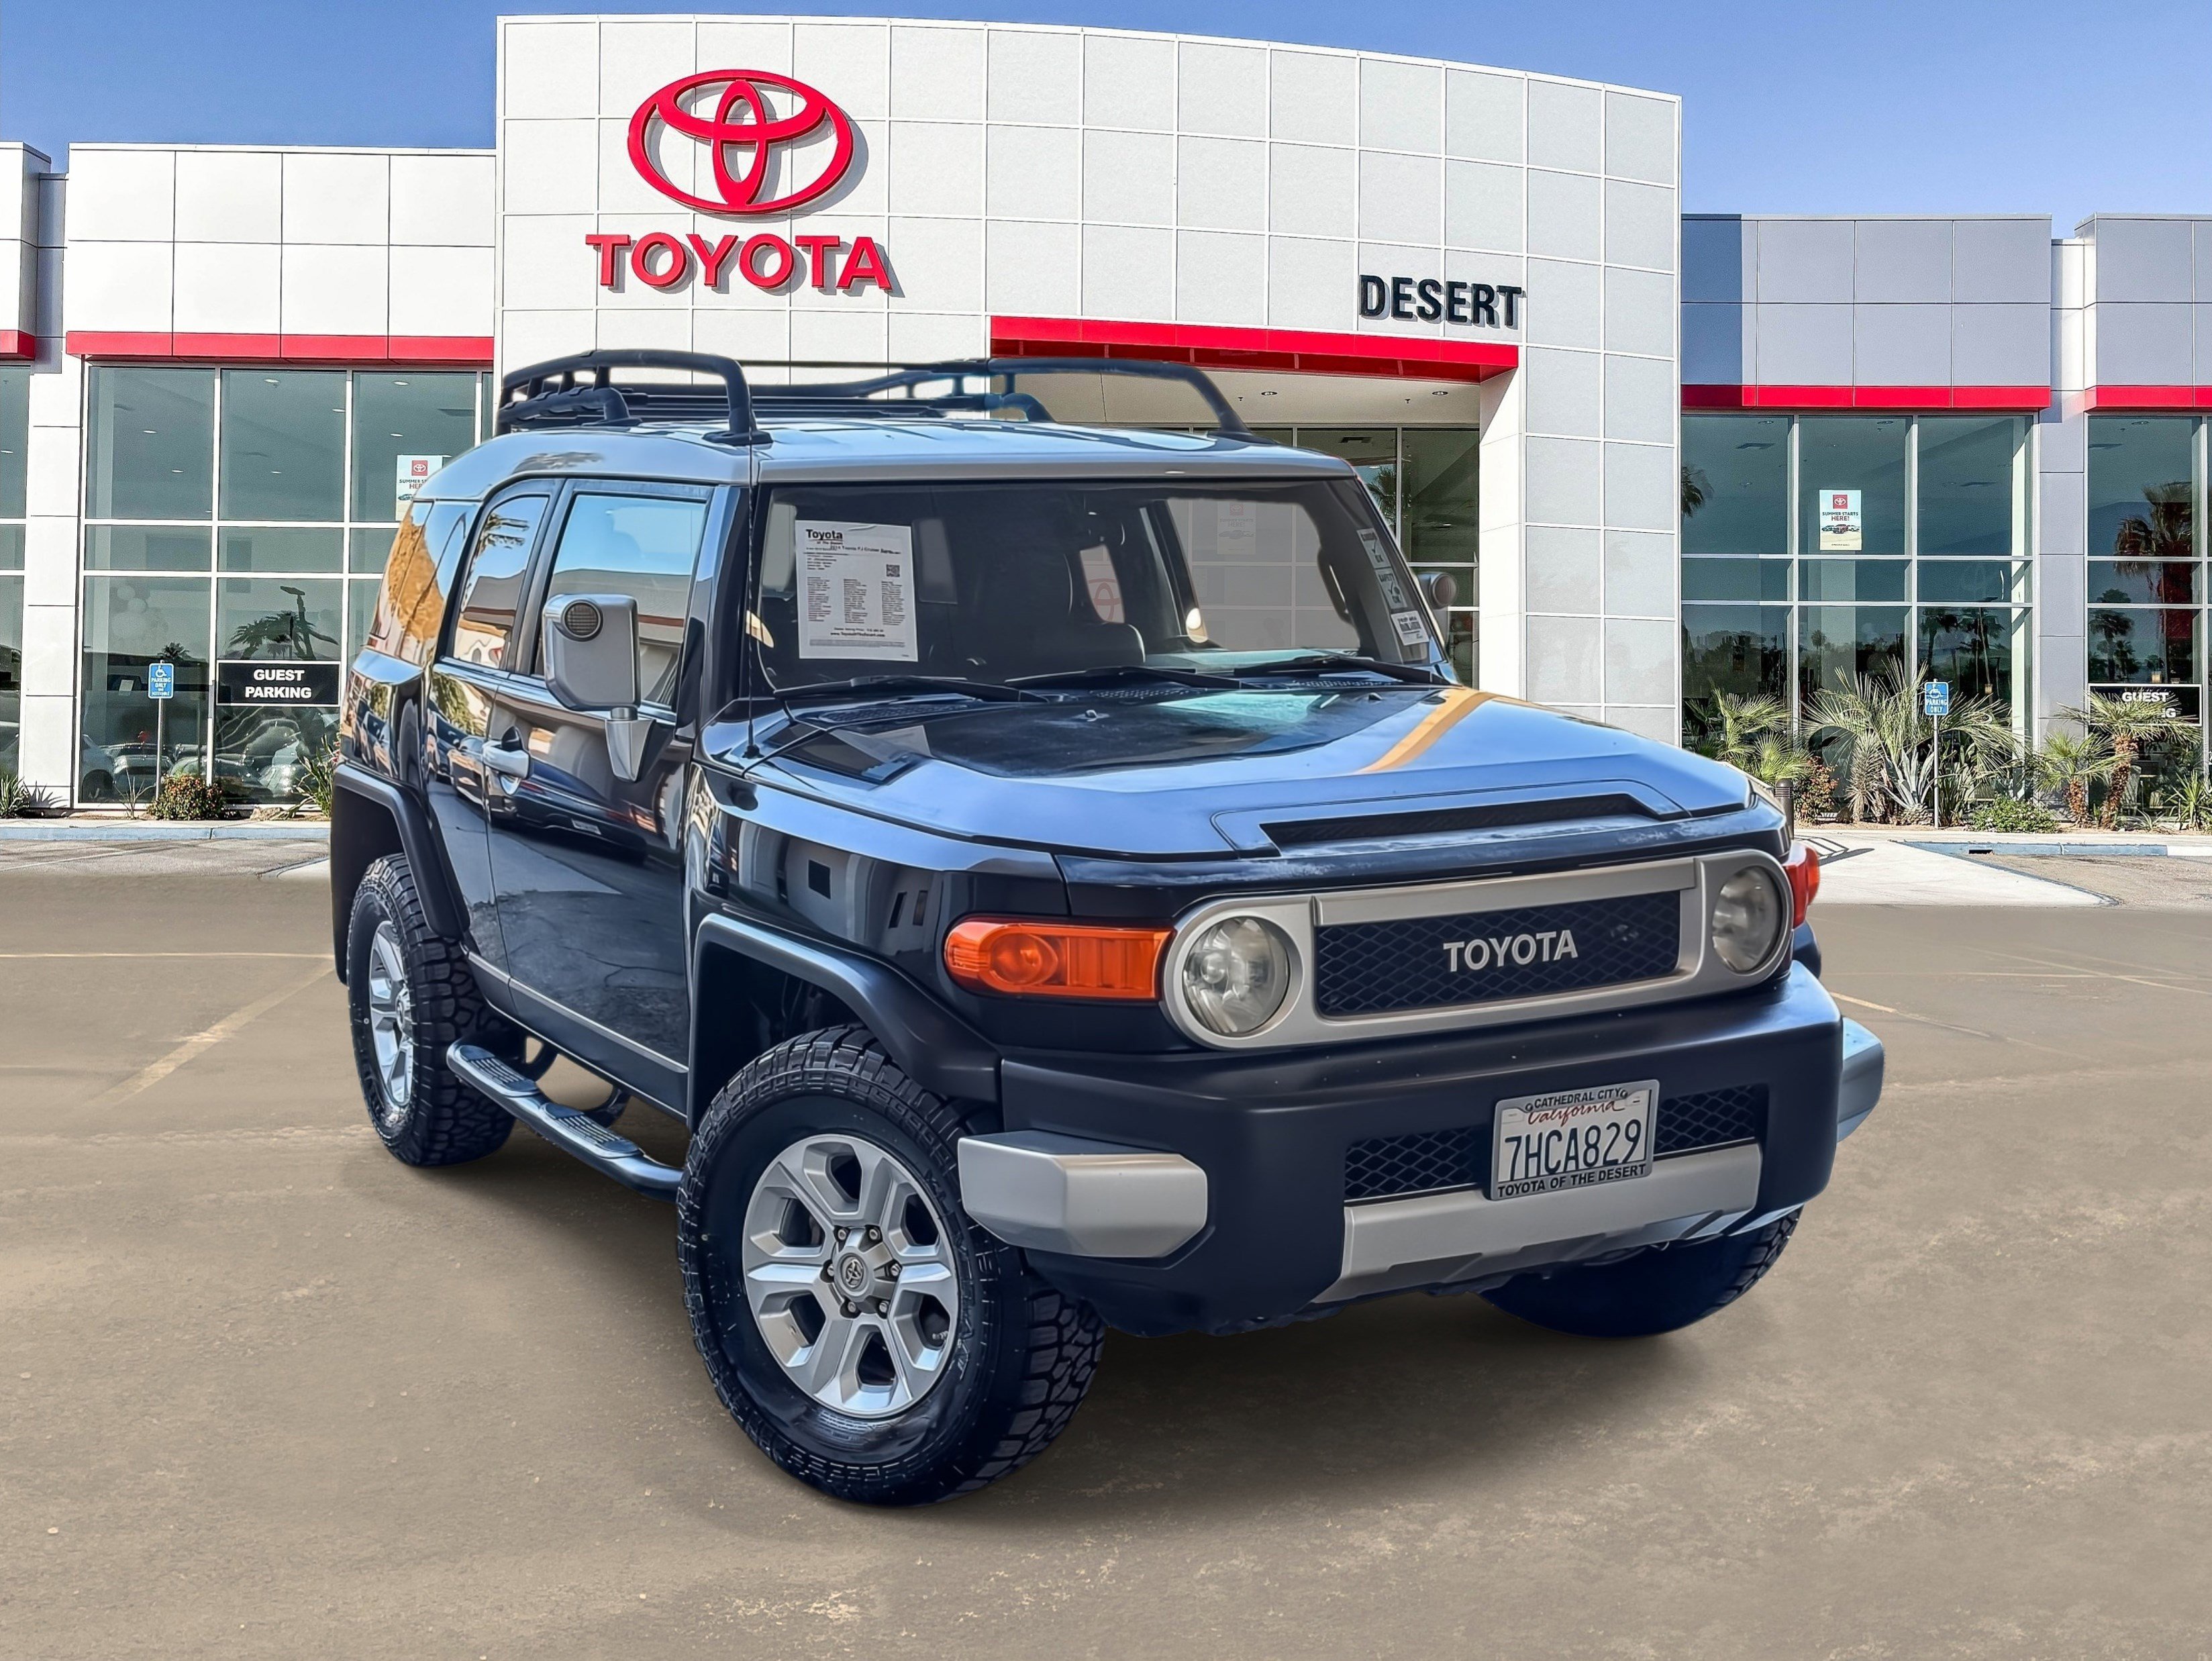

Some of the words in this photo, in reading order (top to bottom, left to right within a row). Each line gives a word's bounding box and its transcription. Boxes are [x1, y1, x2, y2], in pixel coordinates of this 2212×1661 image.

[585, 232, 892, 291] TOYOTA
[1358, 274, 1523, 327] DESERT
[805, 529, 843, 541] Toyota
[253, 669, 305, 681] GUEST
[245, 686, 312, 699] PARKING
[2121, 691, 2170, 703] GUEST
[1443, 929, 1578, 972] TOYOTA
[1534, 1091, 1595, 1109] CATHEDRAL
[1597, 1087, 1621, 1100] CITY
[1527, 1101, 1625, 1127] California
[1505, 1119, 1642, 1181] 7HCA829
[1497, 1180, 1546, 1197] TOYOTA
[1550, 1176, 1567, 1189] OF
[1570, 1172, 1595, 1186] THE
[1598, 1164, 1646, 1181] DESERT
